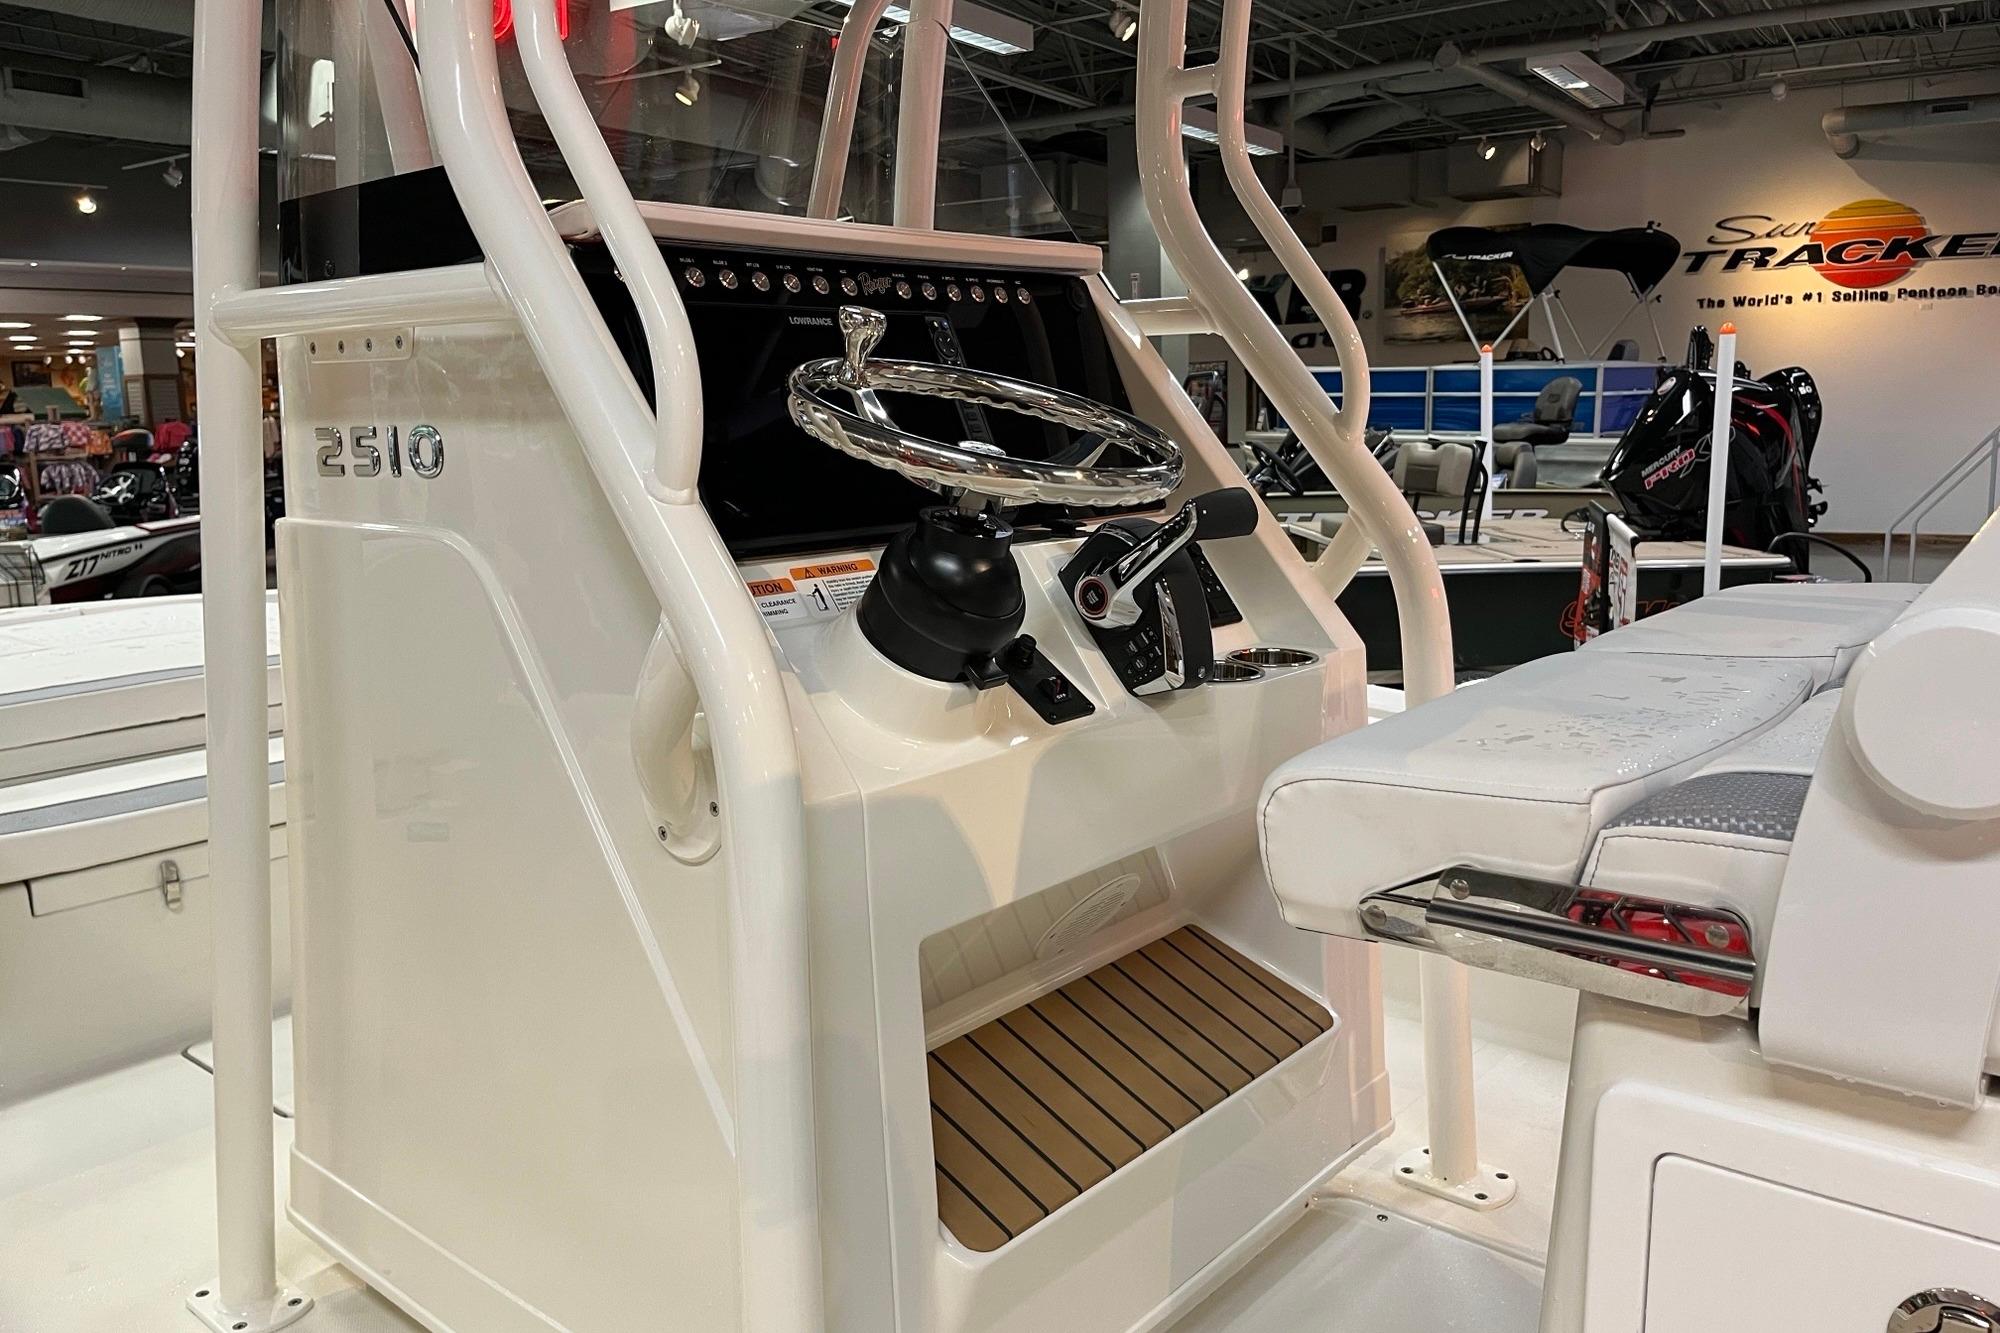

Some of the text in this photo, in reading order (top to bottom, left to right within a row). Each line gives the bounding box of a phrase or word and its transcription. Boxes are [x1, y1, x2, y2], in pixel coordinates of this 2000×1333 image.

[1707, 214, 1825, 244] Sun
[1468, 251, 1514, 261] TRACKER
[1682, 232, 2000, 273] TRACKE
[1697, 298, 1725, 309] The
[1733, 294, 1793, 307] World's
[1831, 289, 1889, 303] Selling
[1898, 286, 1968, 299] Pontoon
[788, 316, 834, 326] LOWRANCE
[315, 424, 444, 479] 2510
[1641, 445, 1682, 477] MERCURY
[1644, 448, 1696, 490] PRO
[64, 545, 132, 581] Z17 NITRO
[816, 563, 859, 576] WARNING
[760, 598, 797, 609] CLEARANCE
